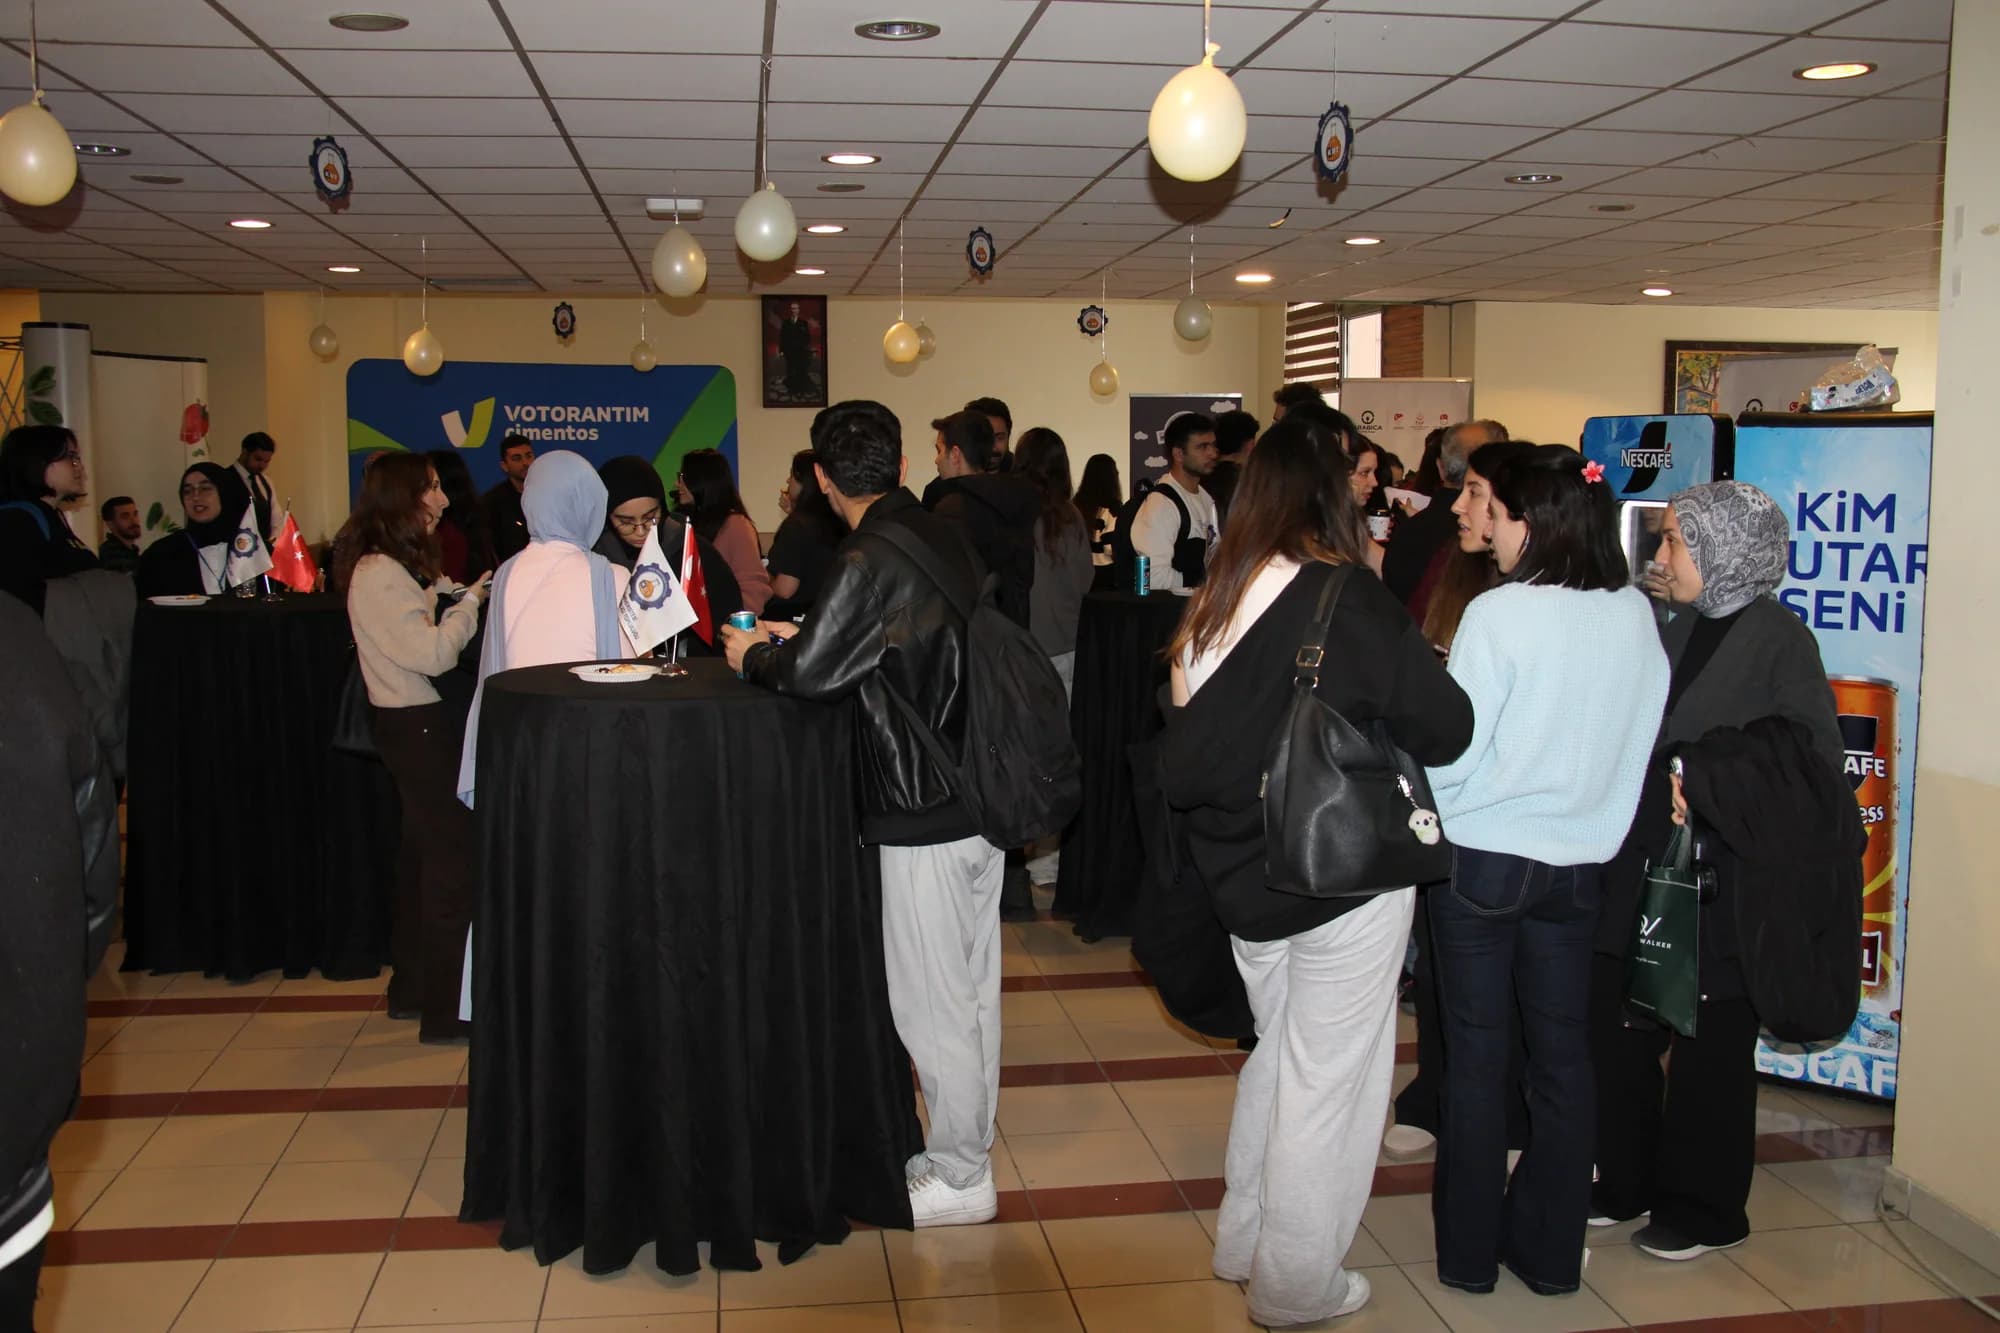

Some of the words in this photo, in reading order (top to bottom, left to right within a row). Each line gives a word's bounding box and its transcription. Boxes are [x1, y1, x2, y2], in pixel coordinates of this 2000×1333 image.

[503, 405, 649, 423] VOTORANTIM
[504, 423, 599, 441] cimentos
[1621, 442, 1672, 469] NESCAFÉ
[1787, 541, 1928, 584] UTAR
[1754, 1042, 1896, 1097] ESCAF
